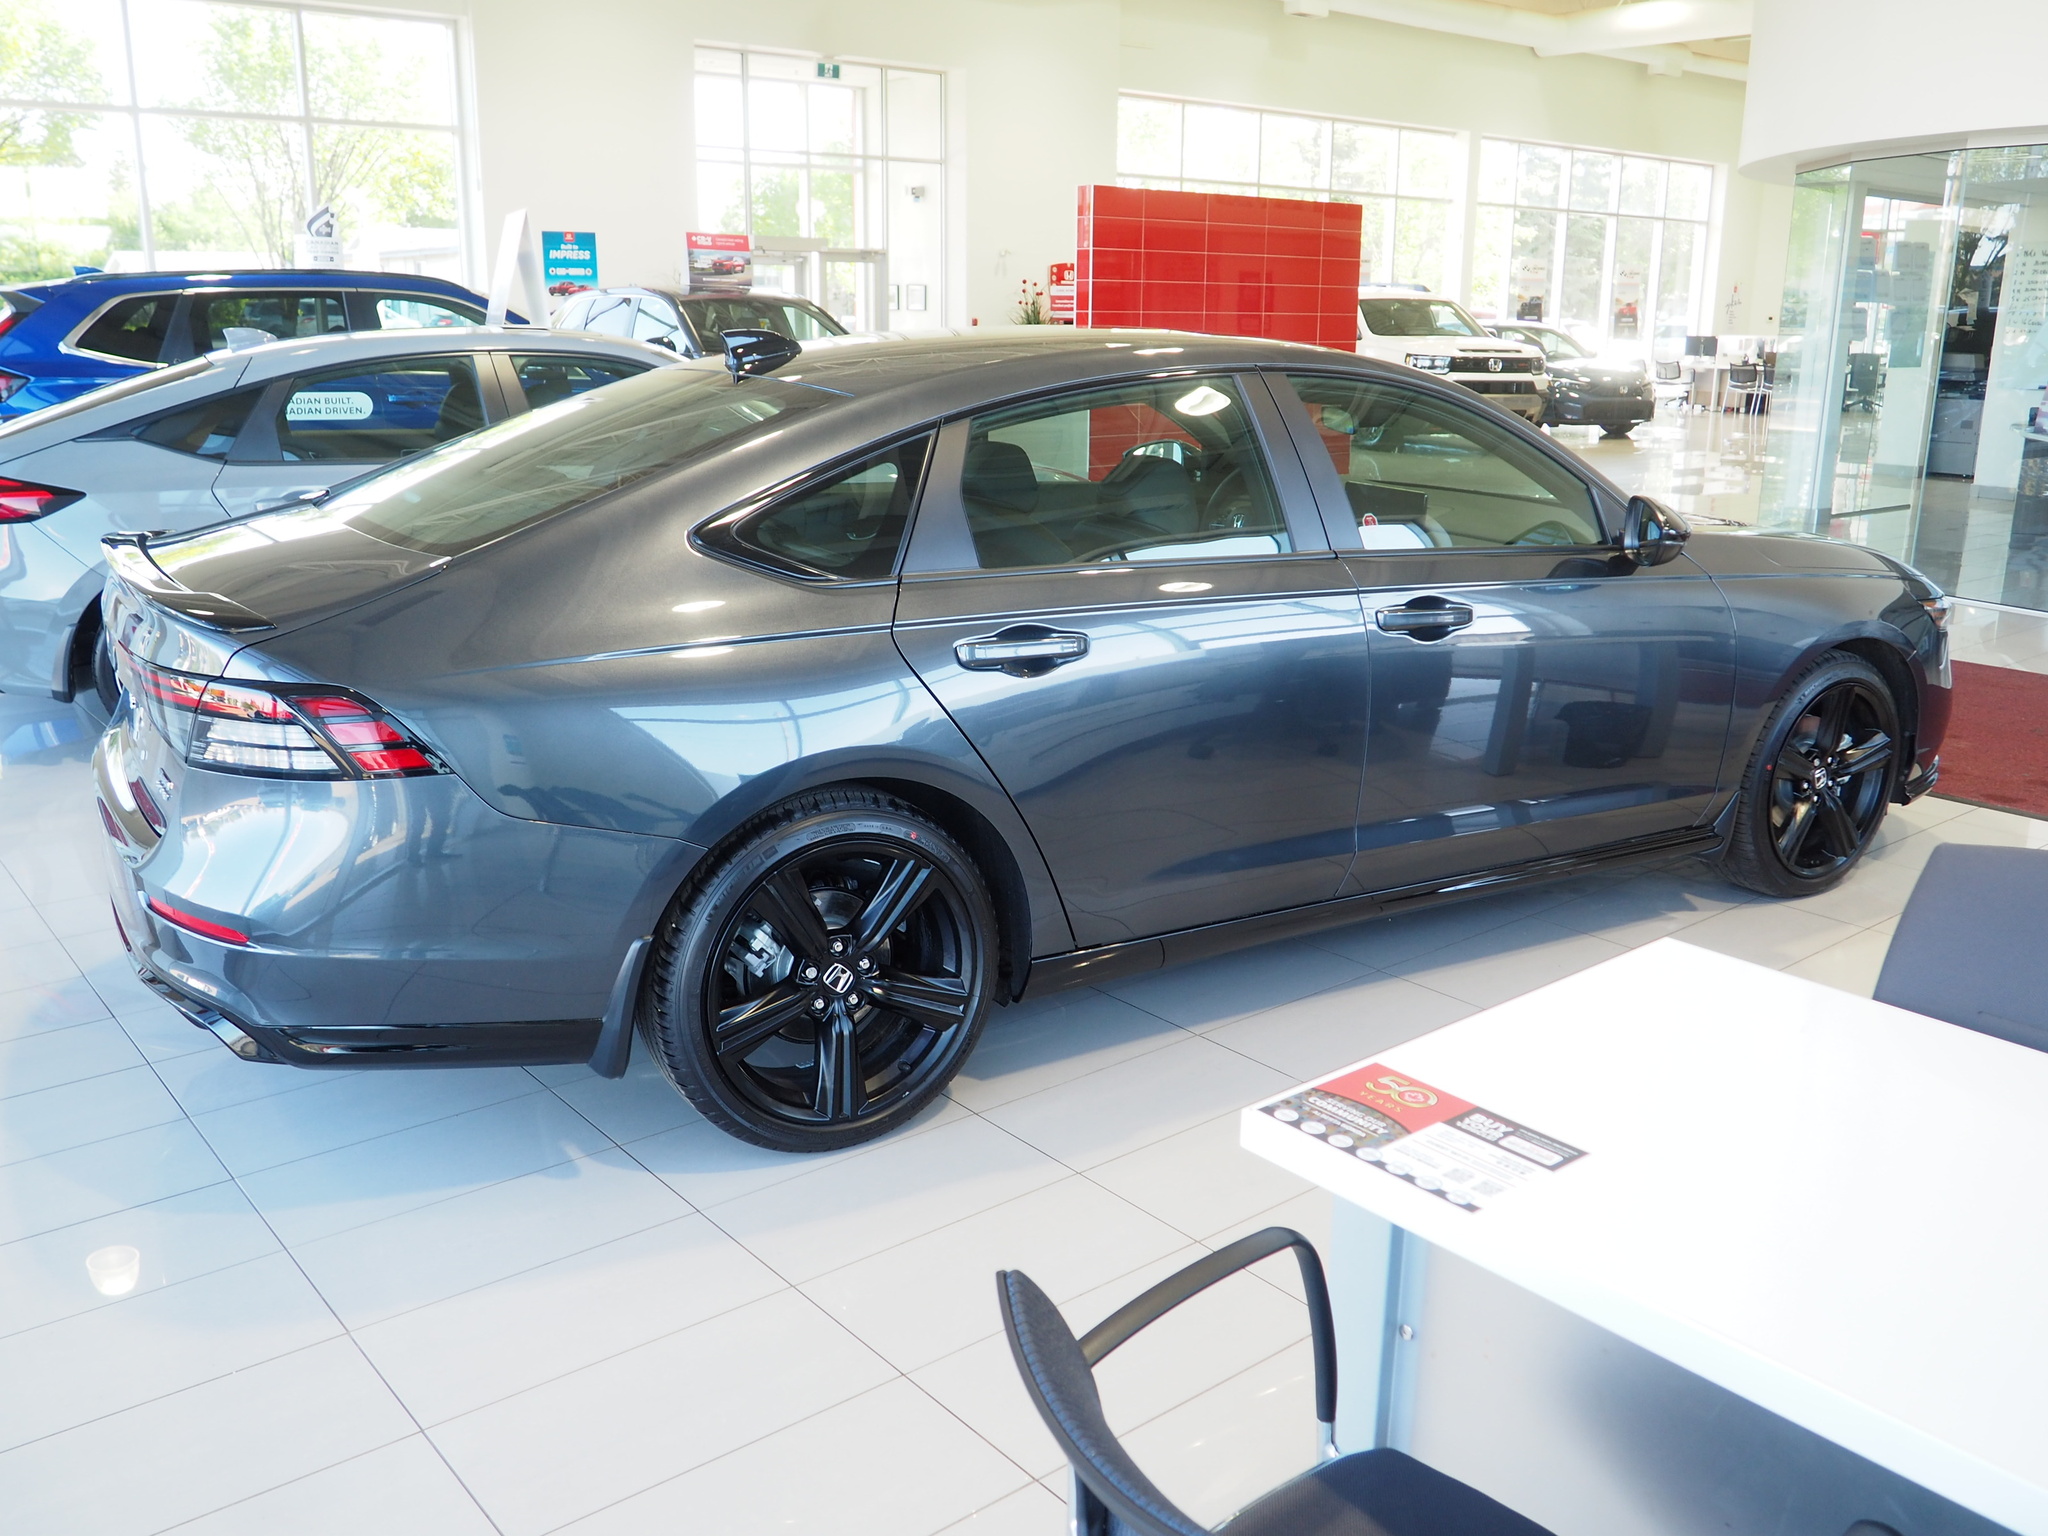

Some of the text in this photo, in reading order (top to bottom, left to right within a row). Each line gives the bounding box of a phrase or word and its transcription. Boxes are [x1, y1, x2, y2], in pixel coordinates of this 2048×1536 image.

[549, 249, 591, 260] IMPRESS
[286, 406, 366, 415] ADIAN DRIVEN.
[289, 397, 354, 405] ADIAN BUILT.
[1360, 1090, 1403, 1113] YEARS
[1365, 1075, 1439, 1108] 50
[1308, 1096, 1389, 1134] COMMUNITY
[1325, 1097, 1366, 1118] SERVING
[1364, 1115, 1388, 1128] OUR
[1468, 1112, 1515, 1135] BUY
